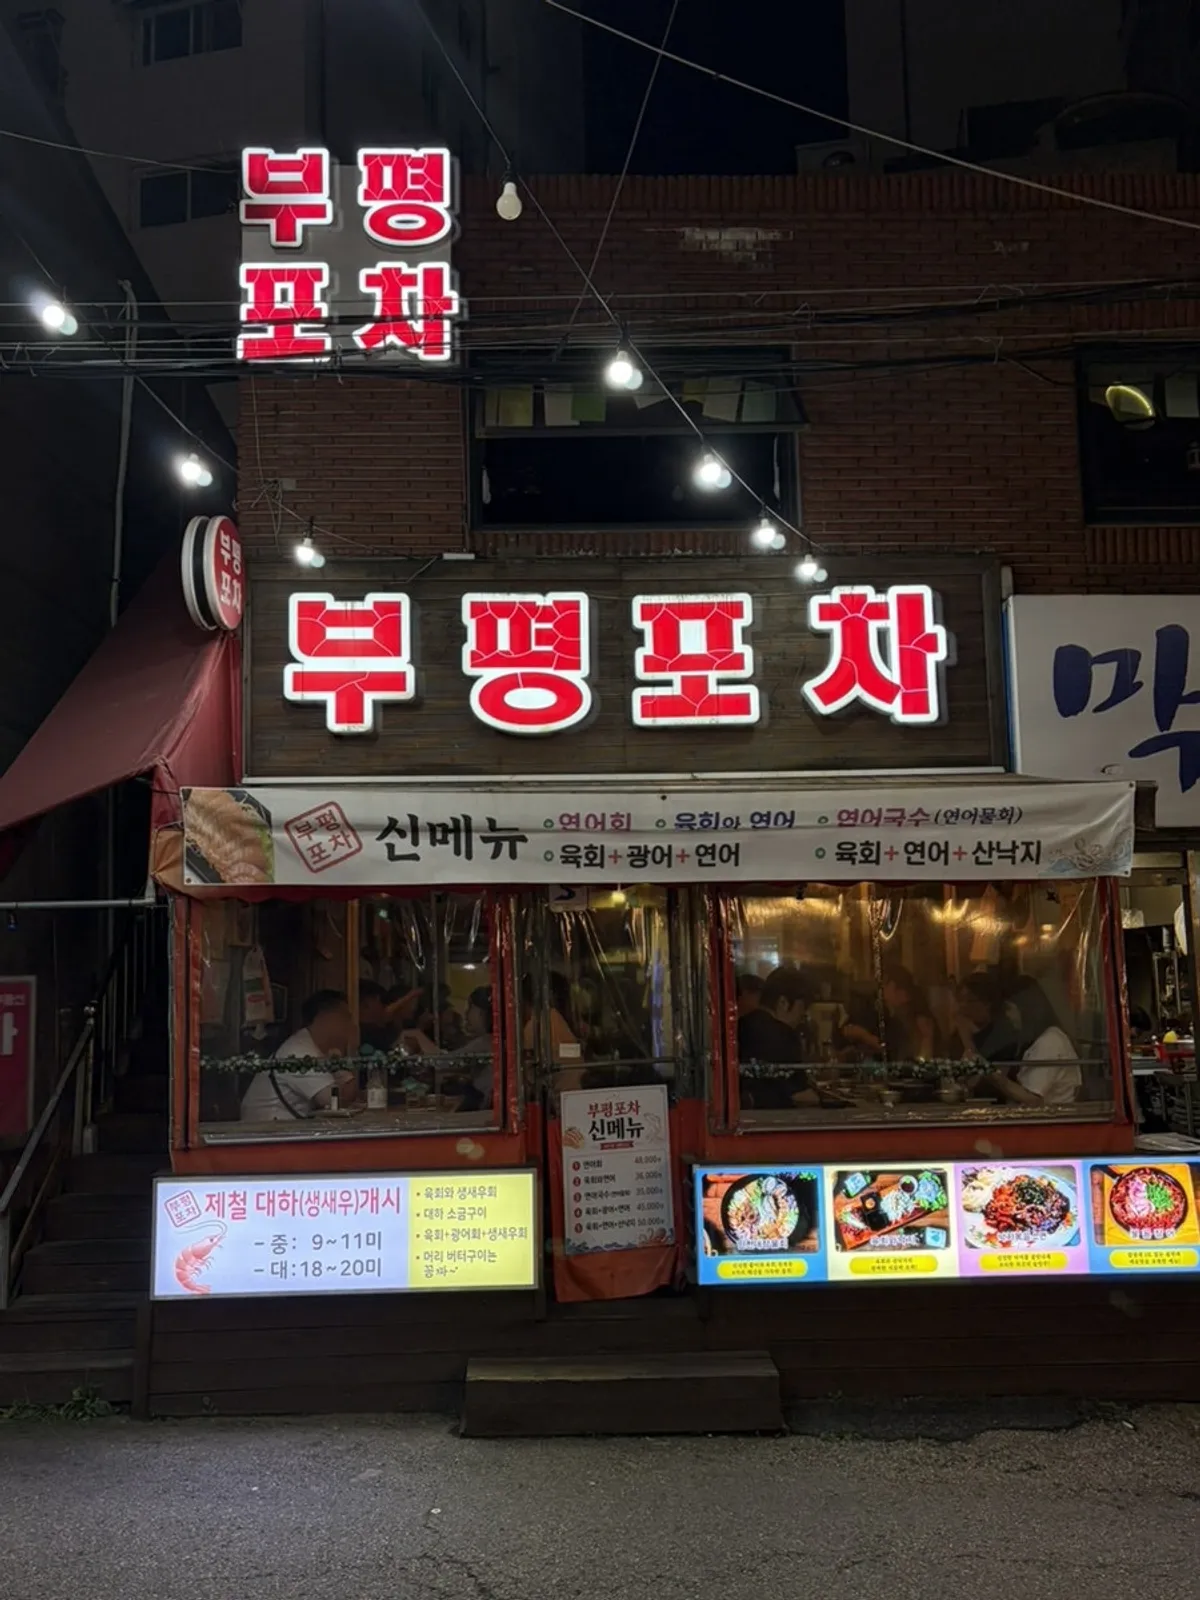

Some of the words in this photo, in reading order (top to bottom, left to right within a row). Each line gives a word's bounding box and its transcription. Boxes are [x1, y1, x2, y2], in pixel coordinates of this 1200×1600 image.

[240, 146, 453, 248] 부평
[236, 261, 461, 363] 포차
[220, 529, 242, 575] 부평
[220, 571, 242, 614] 포차
[283, 584, 947, 735] 부평포차
[294, 809, 341, 840] 부평
[558, 812, 632, 832] 연어회
[749, 810, 795, 829] 연어
[307, 830, 353, 864] 포차
[376, 813, 528, 862] 신메뉴
[587, 1099, 641, 1117] 부평포차
[588, 1117, 645, 1141] 신메뉴
[205, 1190, 248, 1221] 제철
[424, 1187, 454, 1200] 육회와
[457, 1185, 497, 1200] 생새우회
[423, 1208, 444, 1220] 대하
[447, 1206, 487, 1221] 소금구이
[311, 1231, 383, 1251] 9~11미
[423, 1250, 444, 1263] 머리
[446, 1249, 498, 1264] 버터구이는
